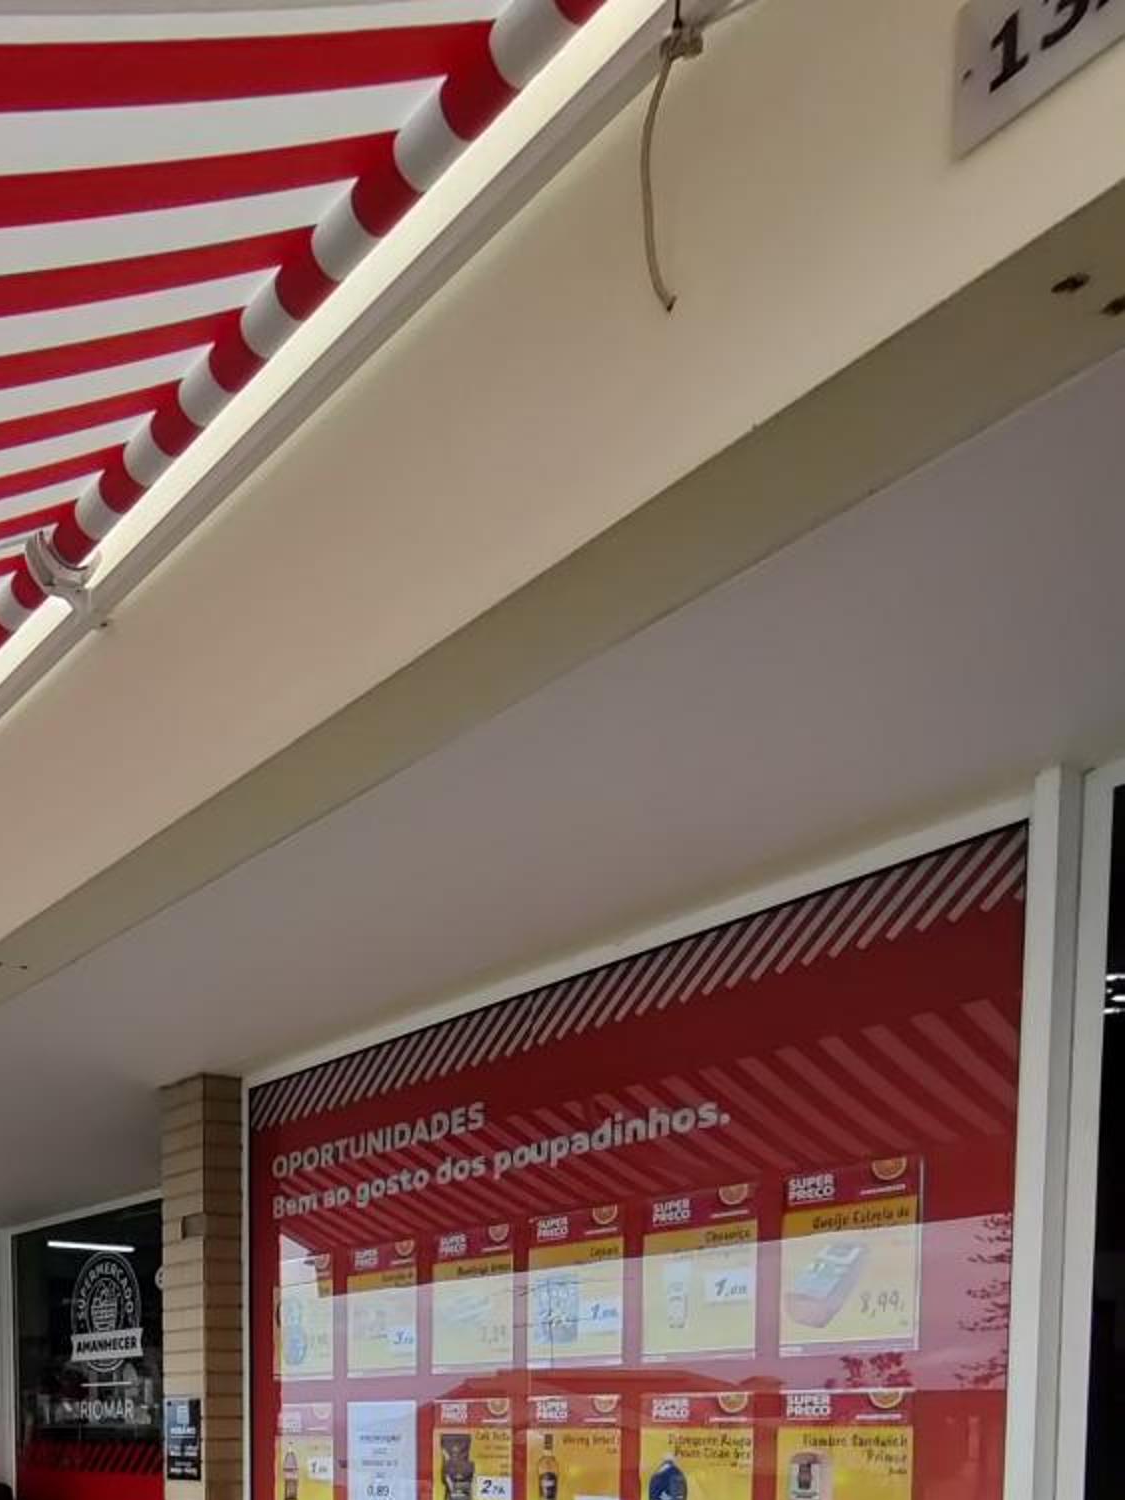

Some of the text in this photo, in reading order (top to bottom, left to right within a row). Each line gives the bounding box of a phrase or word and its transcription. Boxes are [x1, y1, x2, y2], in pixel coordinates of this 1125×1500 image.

[272, 1102, 485, 1178] OPORTUNIDADES
[273, 1101, 730, 1219] Bem ao gosto dos poupadinhos.
[77, 1261, 135, 1320] SUPERMERCADO
[76, 1336, 137, 1354] AMANHECER
